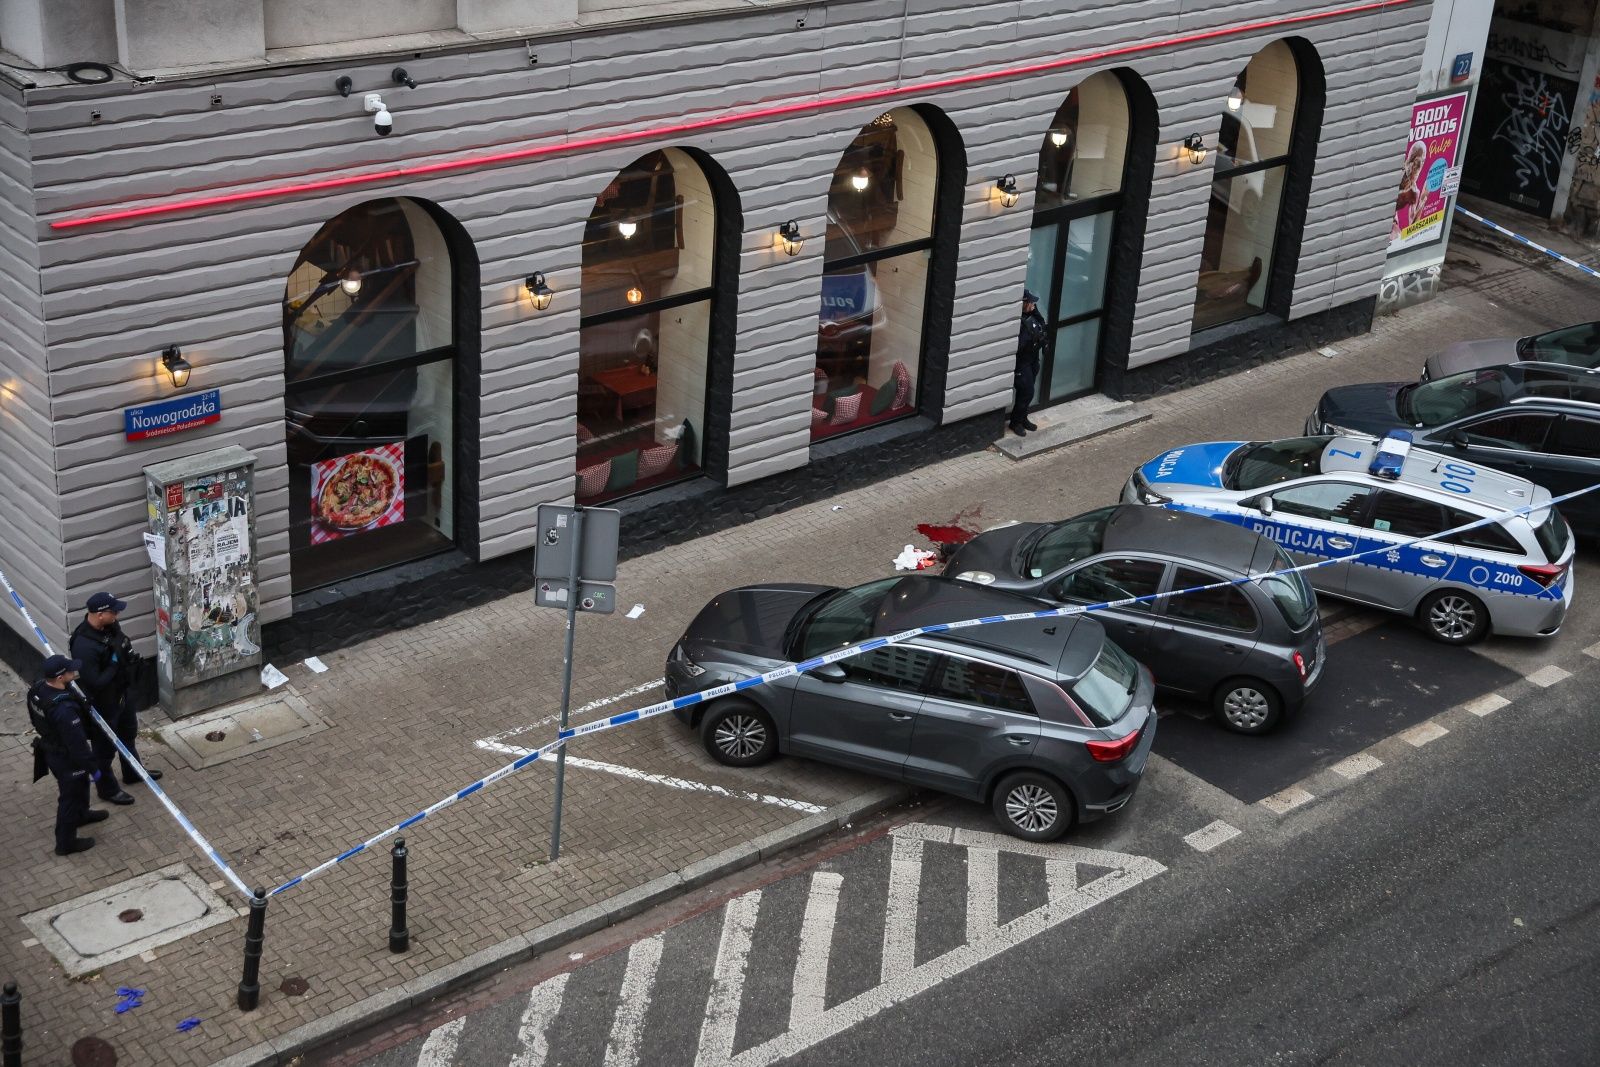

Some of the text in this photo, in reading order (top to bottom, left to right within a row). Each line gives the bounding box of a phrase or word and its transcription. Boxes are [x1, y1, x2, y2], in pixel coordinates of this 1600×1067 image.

[1457, 60, 1470, 75] 22
[1415, 104, 1453, 126] BODY
[1406, 213, 1438, 235] WARSZAWA
[132, 401, 215, 430] Nowogrodzka
[1494, 571, 1523, 587] Z010
[768, 668, 792, 679] POLICJA
[707, 686, 731, 697] POLICJA
[645, 704, 668, 714] POLICJA
[581, 722, 605, 733] POLICJA
